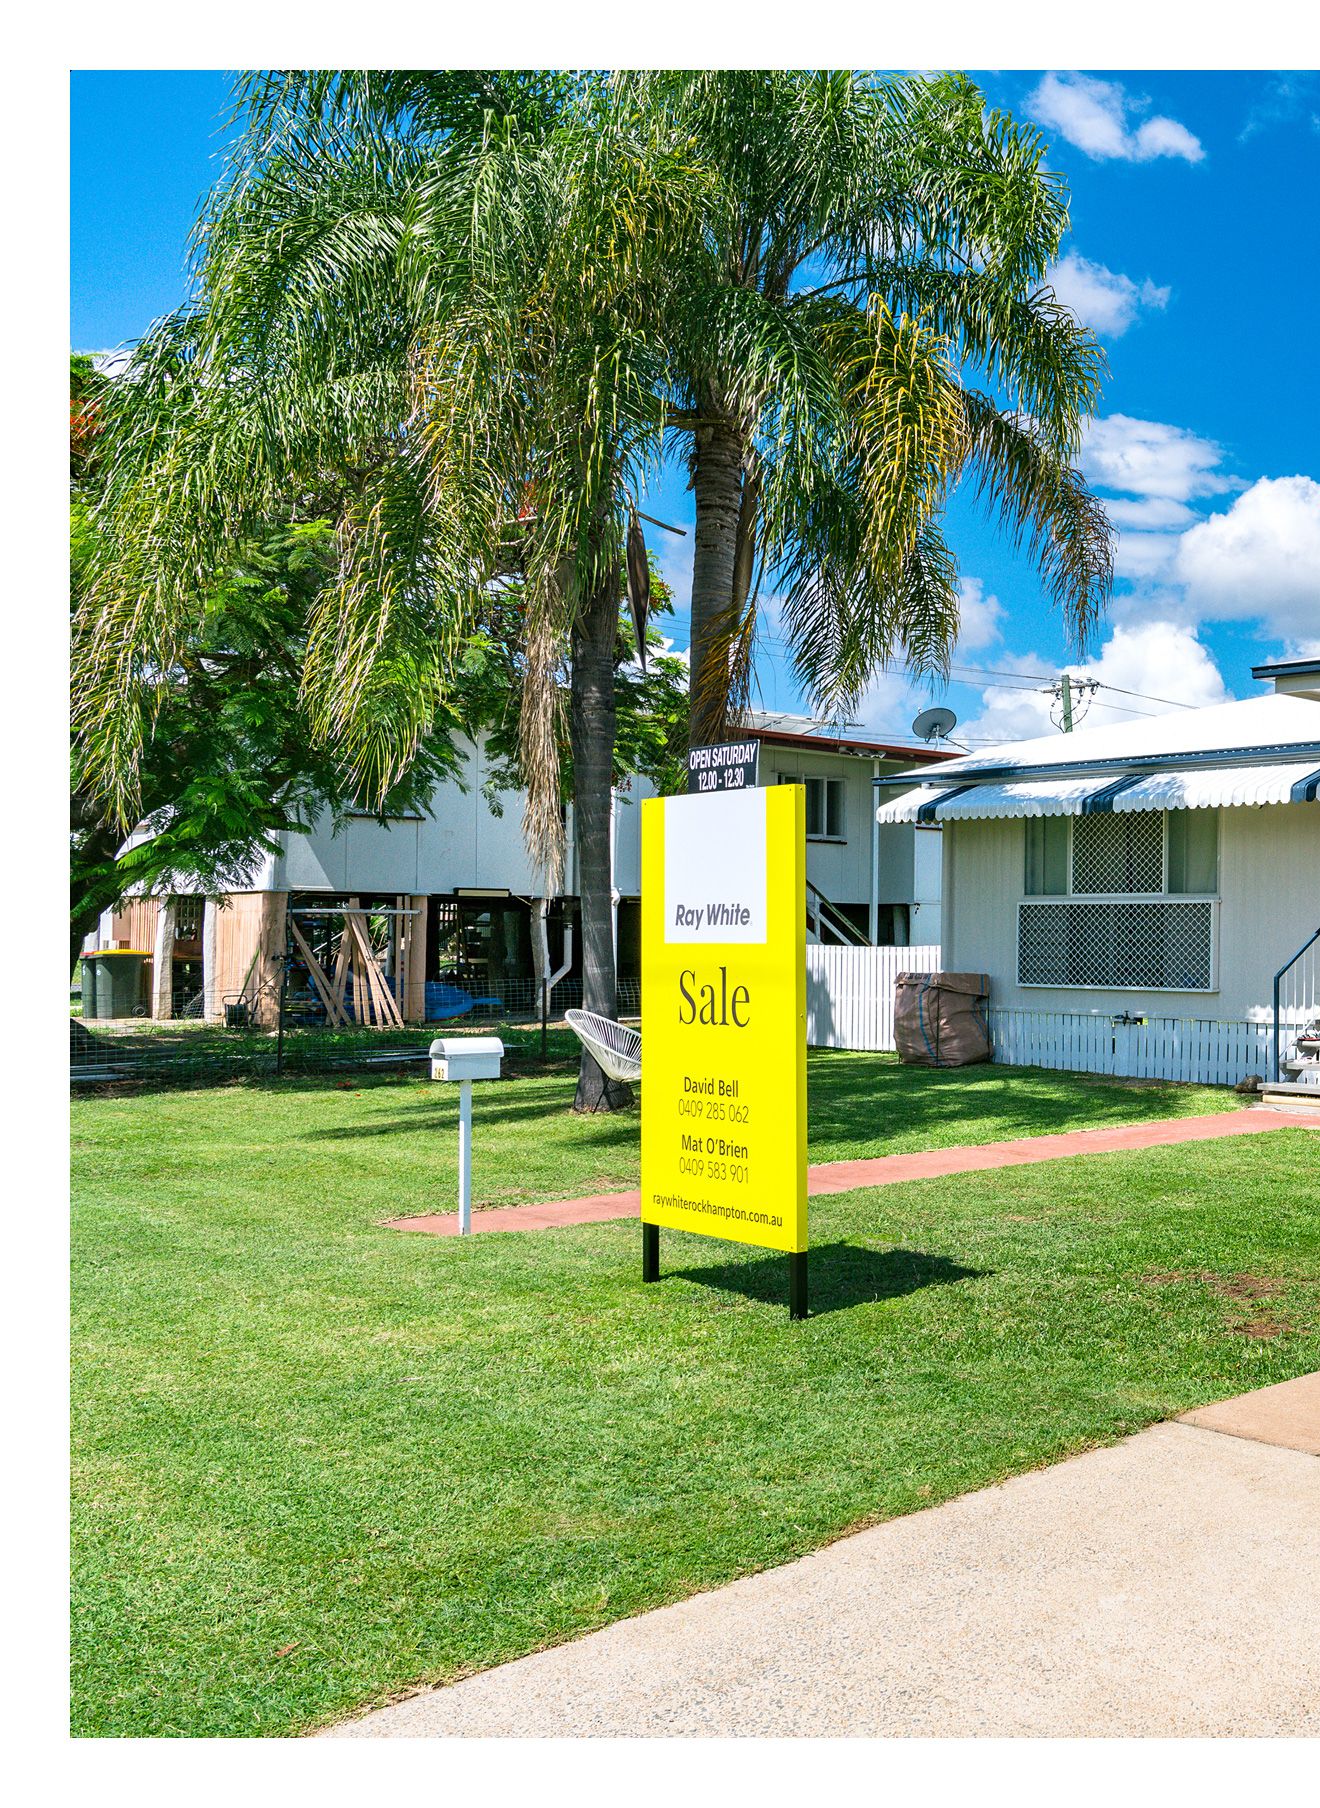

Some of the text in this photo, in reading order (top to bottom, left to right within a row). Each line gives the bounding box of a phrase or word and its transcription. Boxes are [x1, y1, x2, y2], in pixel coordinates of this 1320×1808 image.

[690, 743, 757, 770] OPEN SATURDAY
[698, 770, 717, 791] 12.00
[724, 767, 744, 788] 12.30
[675, 903, 750, 930] Ray White
[679, 966, 750, 1028] Sale
[684, 1076, 739, 1098] David Bell
[678, 1098, 749, 1124] 0409 285 062
[681, 1134, 748, 1160] Mat O'Brien
[679, 1157, 749, 1184] 0409 583 901
[653, 1193, 783, 1228] raywhiterockhampton.com.au
